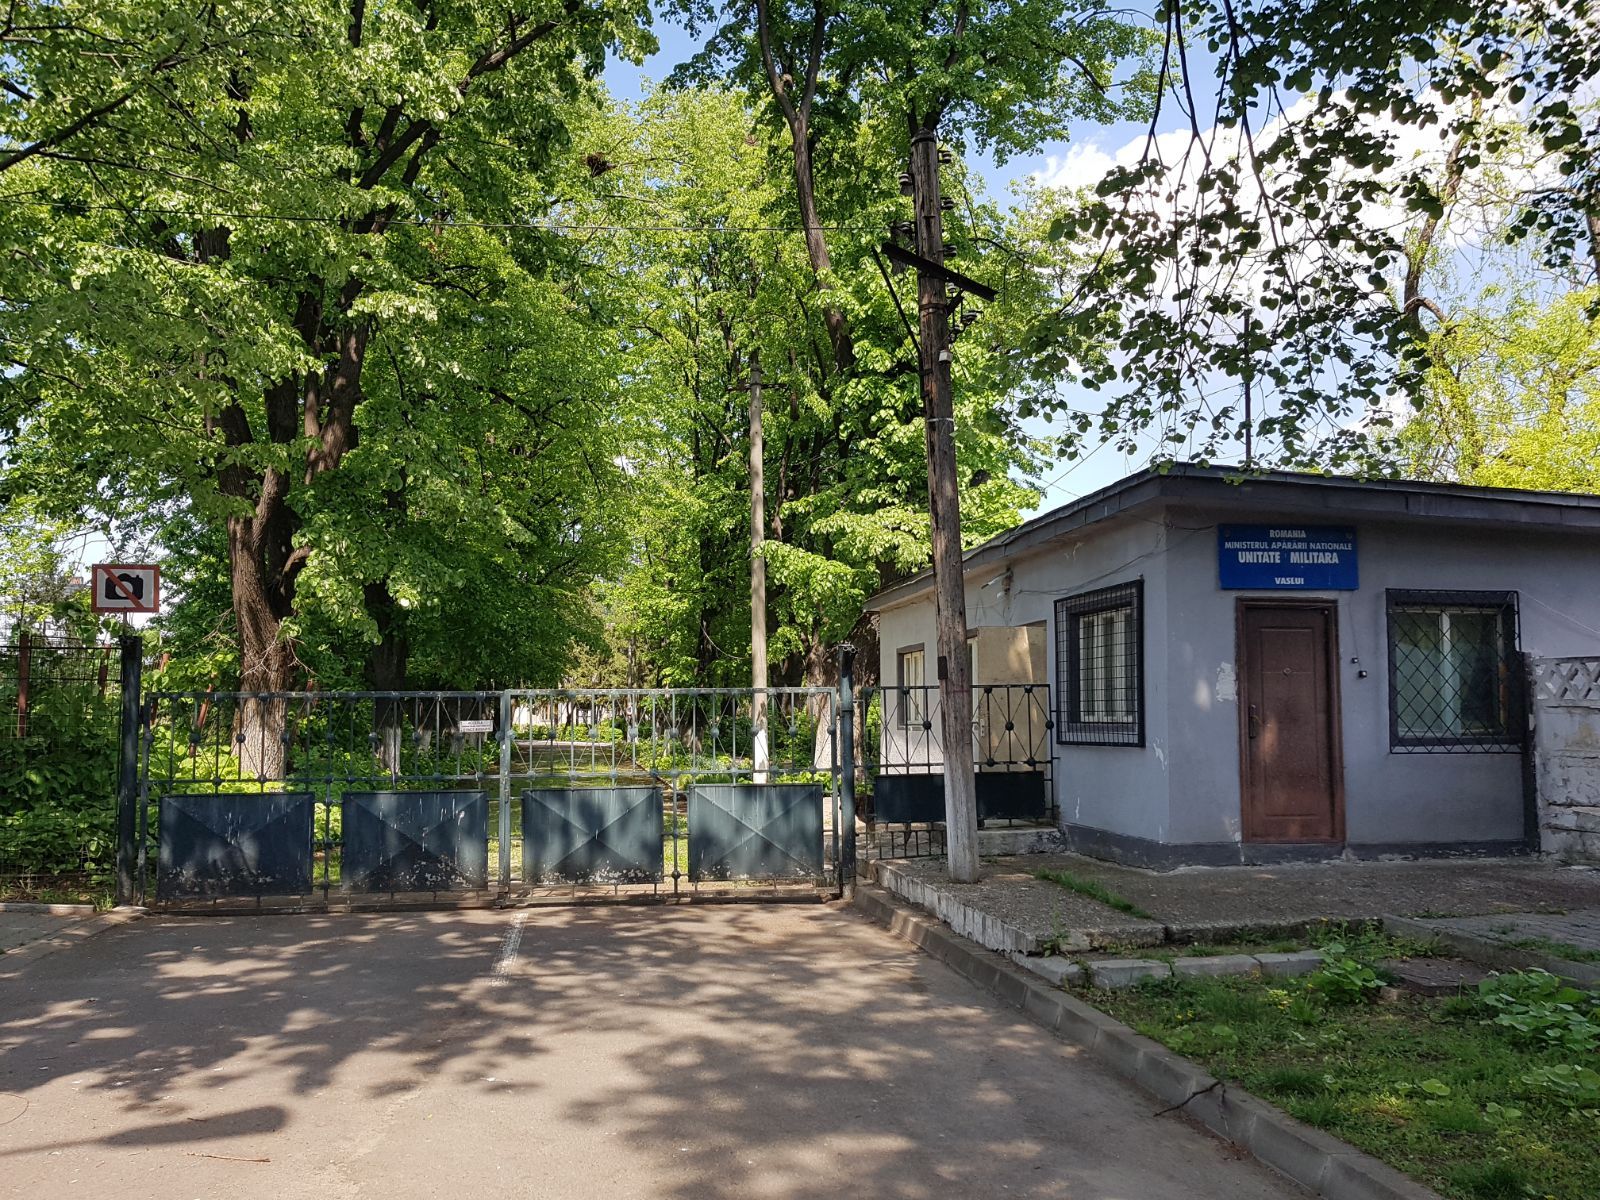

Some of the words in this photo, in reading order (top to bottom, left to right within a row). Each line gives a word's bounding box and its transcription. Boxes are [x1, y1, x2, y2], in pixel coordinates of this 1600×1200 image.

[1269, 529, 1306, 538] ROMANIA
[1225, 541, 1269, 550] MINISTERUL
[1309, 542, 1352, 551] NATIONALE
[1238, 552, 1281, 564] UNITATE
[1290, 553, 1339, 564] MILITARA
[1275, 577, 1304, 585] VASLUI
